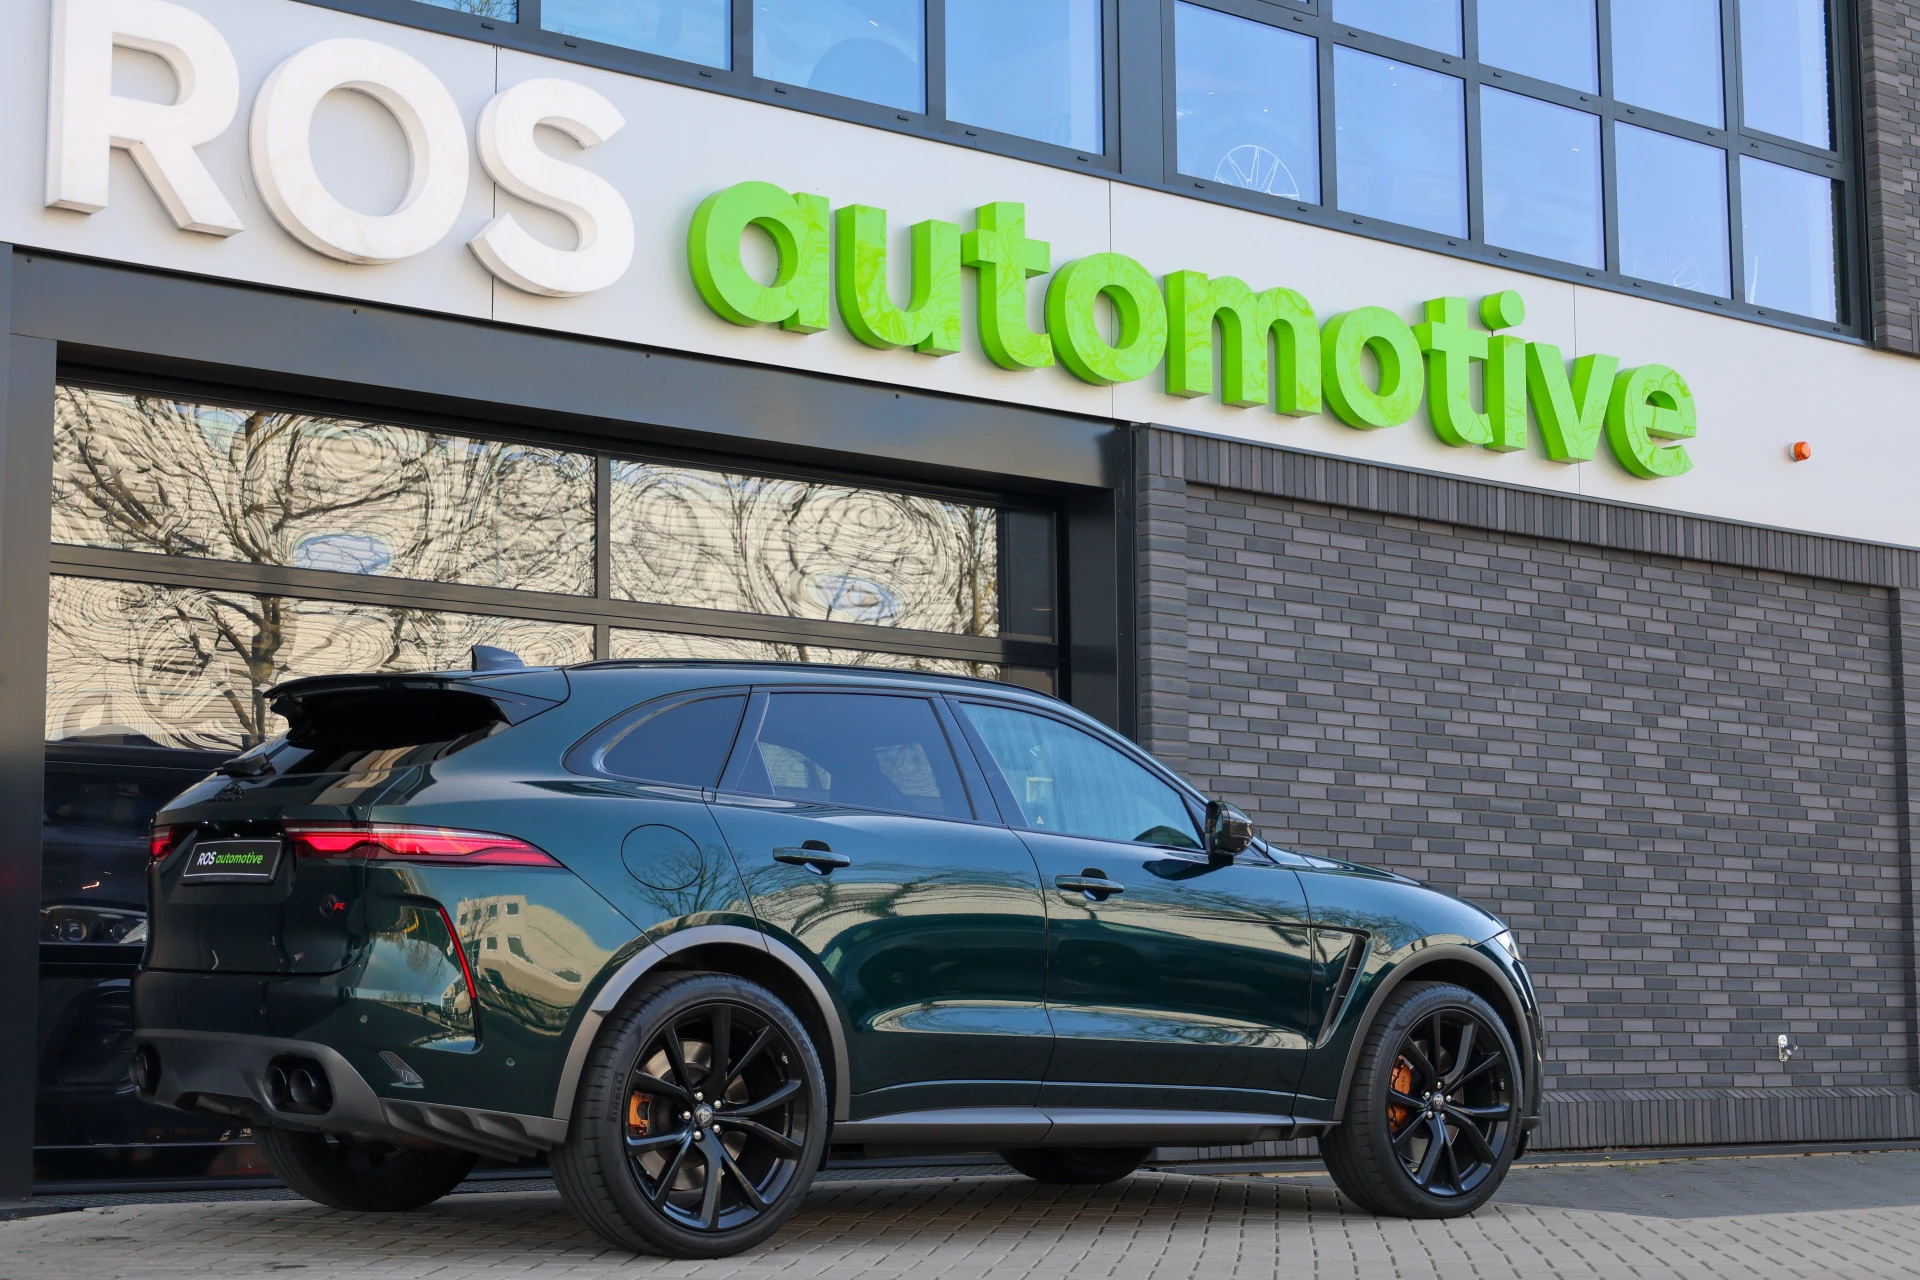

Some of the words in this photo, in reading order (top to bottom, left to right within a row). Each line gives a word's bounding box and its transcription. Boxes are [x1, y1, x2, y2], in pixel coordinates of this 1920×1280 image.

[45, 0, 635, 298] ROS
[687, 181, 1696, 480] automotive
[197, 851, 217, 866] ROS
[215, 851, 264, 865] automotive
